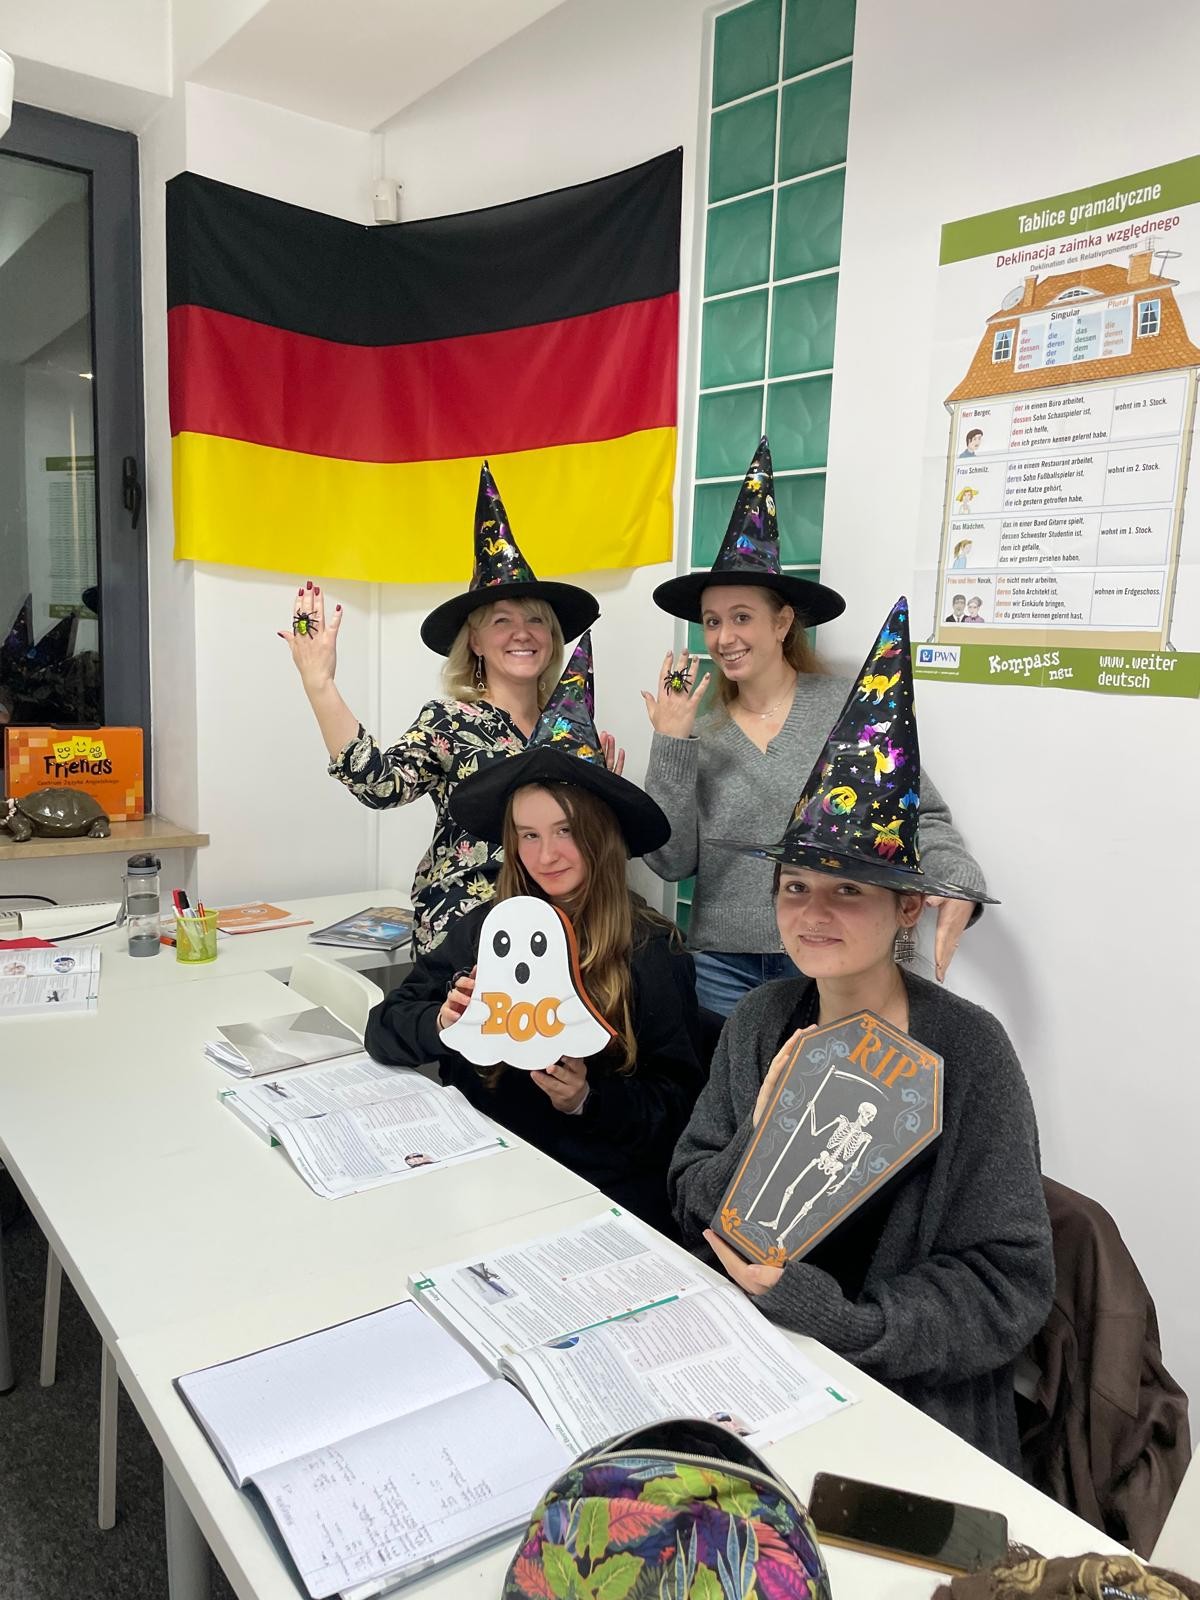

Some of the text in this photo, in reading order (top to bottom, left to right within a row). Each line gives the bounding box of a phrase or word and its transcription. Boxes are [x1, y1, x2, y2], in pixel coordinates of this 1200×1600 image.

[1019, 183, 1161, 233] Tablice gramatyczne
[997, 216, 1180, 268] Deklinacja zaimka względnego
[1030, 242, 1138, 272] Deklination des Relativpronomens
[1051, 309, 1080, 320] Singular
[1048, 332, 1058, 340] die
[1075, 334, 1096, 343] dessen
[1047, 340, 1065, 348] deren
[1074, 344, 1088, 352] dem
[1115, 402, 1132, 410] wohnt
[1150, 397, 1167, 406] Stock.
[1033, 414, 1046, 422] Sohn
[1048, 410, 1082, 420] Schauspieler
[1031, 438, 1050, 446] gestern
[1072, 433, 1091, 442] gelernt
[1041, 460, 1070, 468] Restaurant
[1108, 466, 1125, 474] wohnt
[1135, 464, 1140, 472] 2.
[1142, 462, 1160, 471] Stock.
[1023, 474, 1036, 482] Sohn
[1023, 498, 1043, 506] gestern
[1049, 518, 1067, 526] Gitarre
[1021, 531, 1047, 539] Schwester
[1049, 530, 1073, 538] Studentin
[1101, 527, 1118, 535] wohnt
[1039, 555, 1061, 563] gesehen
[1124, 587, 1160, 596] Erdgeschoss.
[1051, 612, 1069, 620] gelernt
[934, 651, 957, 661] PWN
[988, 651, 1060, 678] Kompass
[1099, 654, 1178, 671] www.weiter
[1049, 668, 1073, 680] neu
[1098, 672, 1150, 688] deutsch
[44, 756, 112, 778] Friends
[848, 1030, 918, 1089] RIP
